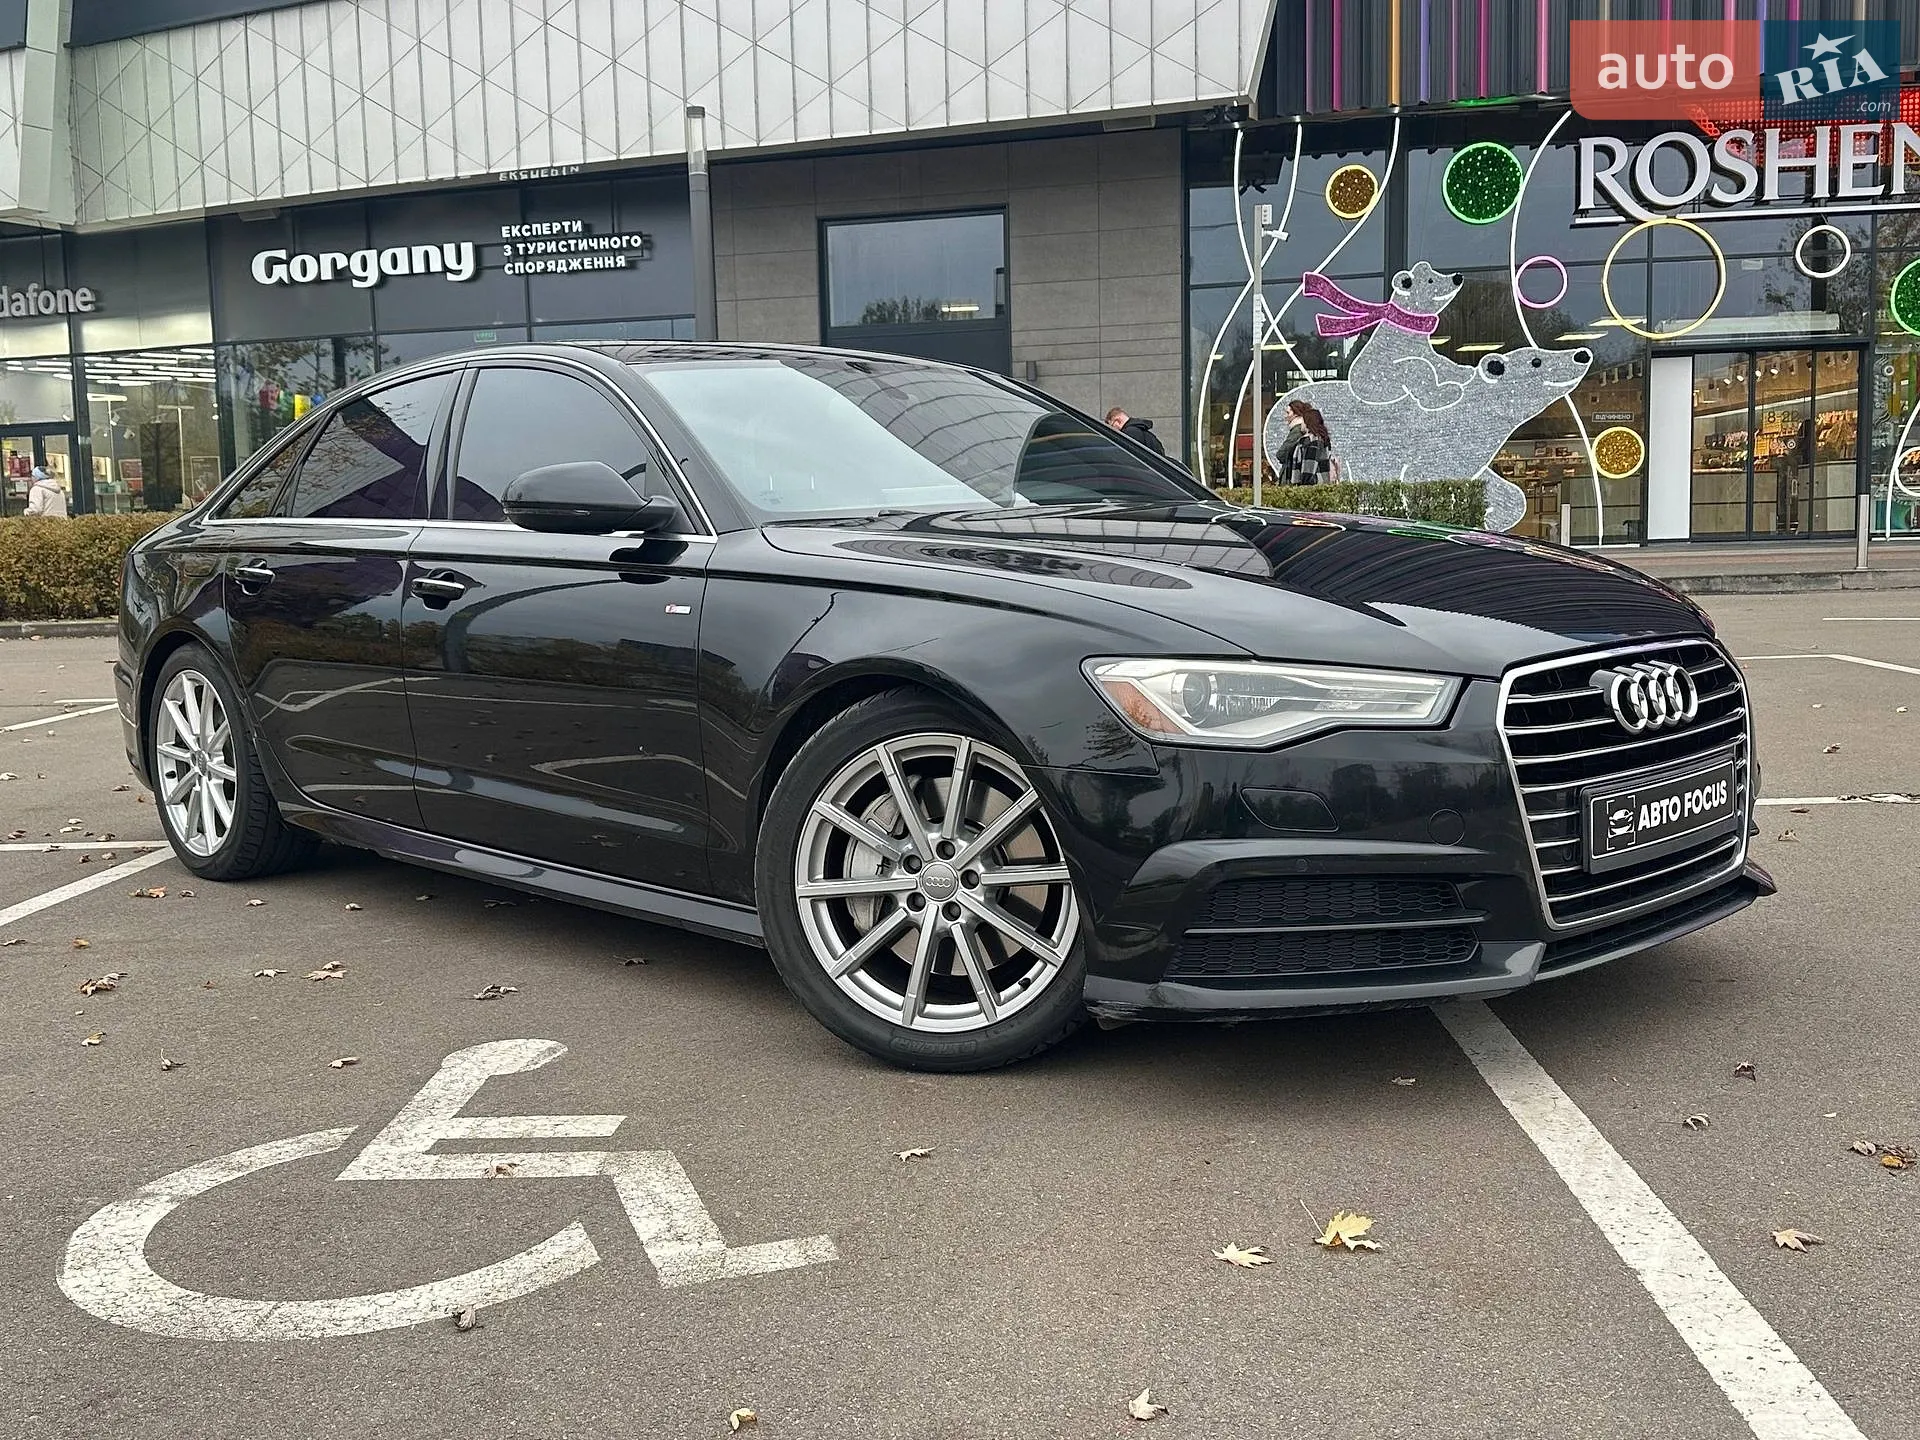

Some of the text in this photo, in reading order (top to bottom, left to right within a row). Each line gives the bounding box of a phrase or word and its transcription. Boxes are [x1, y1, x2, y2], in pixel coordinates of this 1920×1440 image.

[501, 220, 583, 238] ЕКСПЕРТИ
[517, 235, 642, 255] ТУРИСТИЧНОГО
[251, 241, 477, 288] Gorgany
[503, 255, 626, 275] СПОРЯДЖЕННЯ
[1684, 780, 1728, 818] FOCUS
